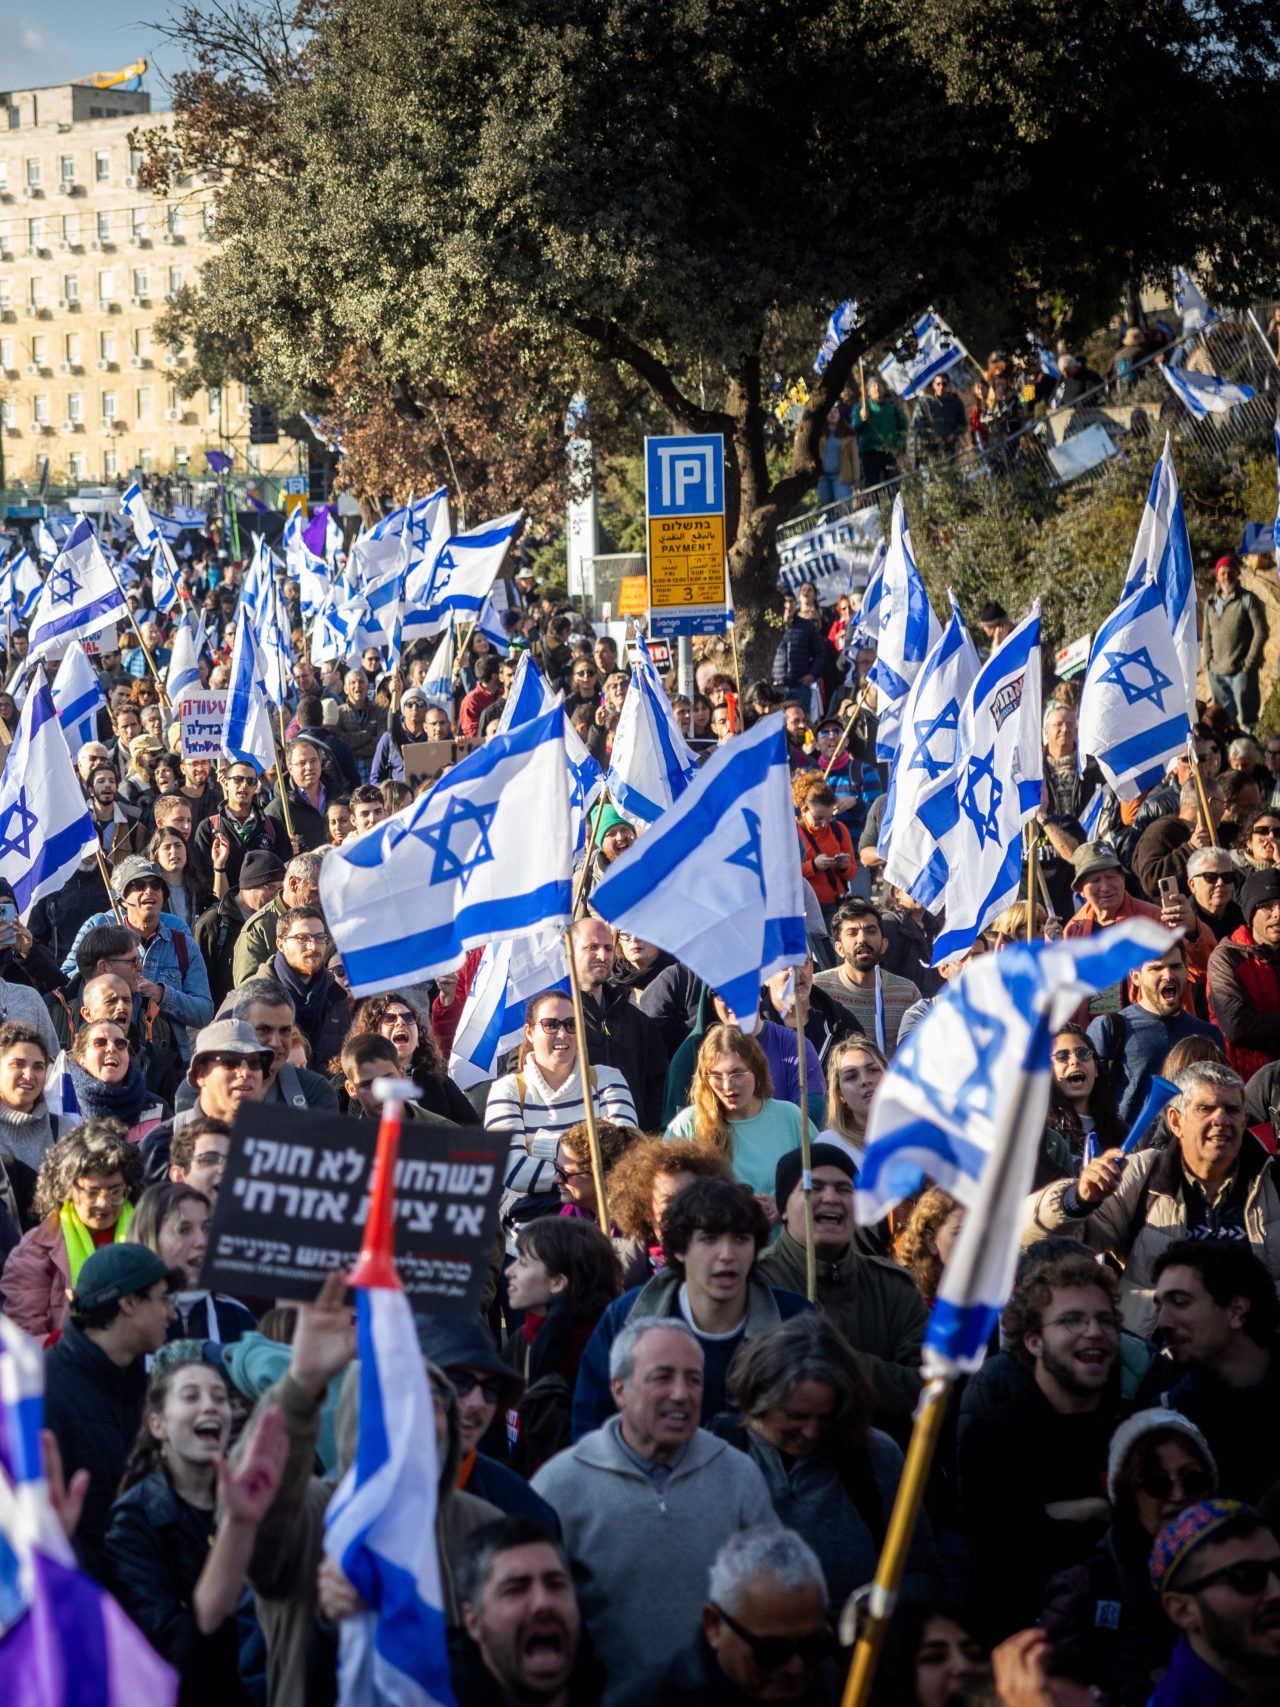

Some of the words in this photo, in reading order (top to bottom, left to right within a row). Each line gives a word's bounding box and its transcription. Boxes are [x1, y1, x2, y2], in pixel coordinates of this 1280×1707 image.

[662, 521, 711, 531] בתשלום
[662, 543, 712, 552] PAYMENT
[683, 587, 694, 601] 3
[187, 720, 224, 735] בדילה
[243, 1137, 315, 1177] חוקי
[316, 1147, 366, 1184] לא
[370, 1158, 495, 1196] כשהחו
[232, 1176, 350, 1224] אזרחי
[444, 1203, 486, 1237] אי
